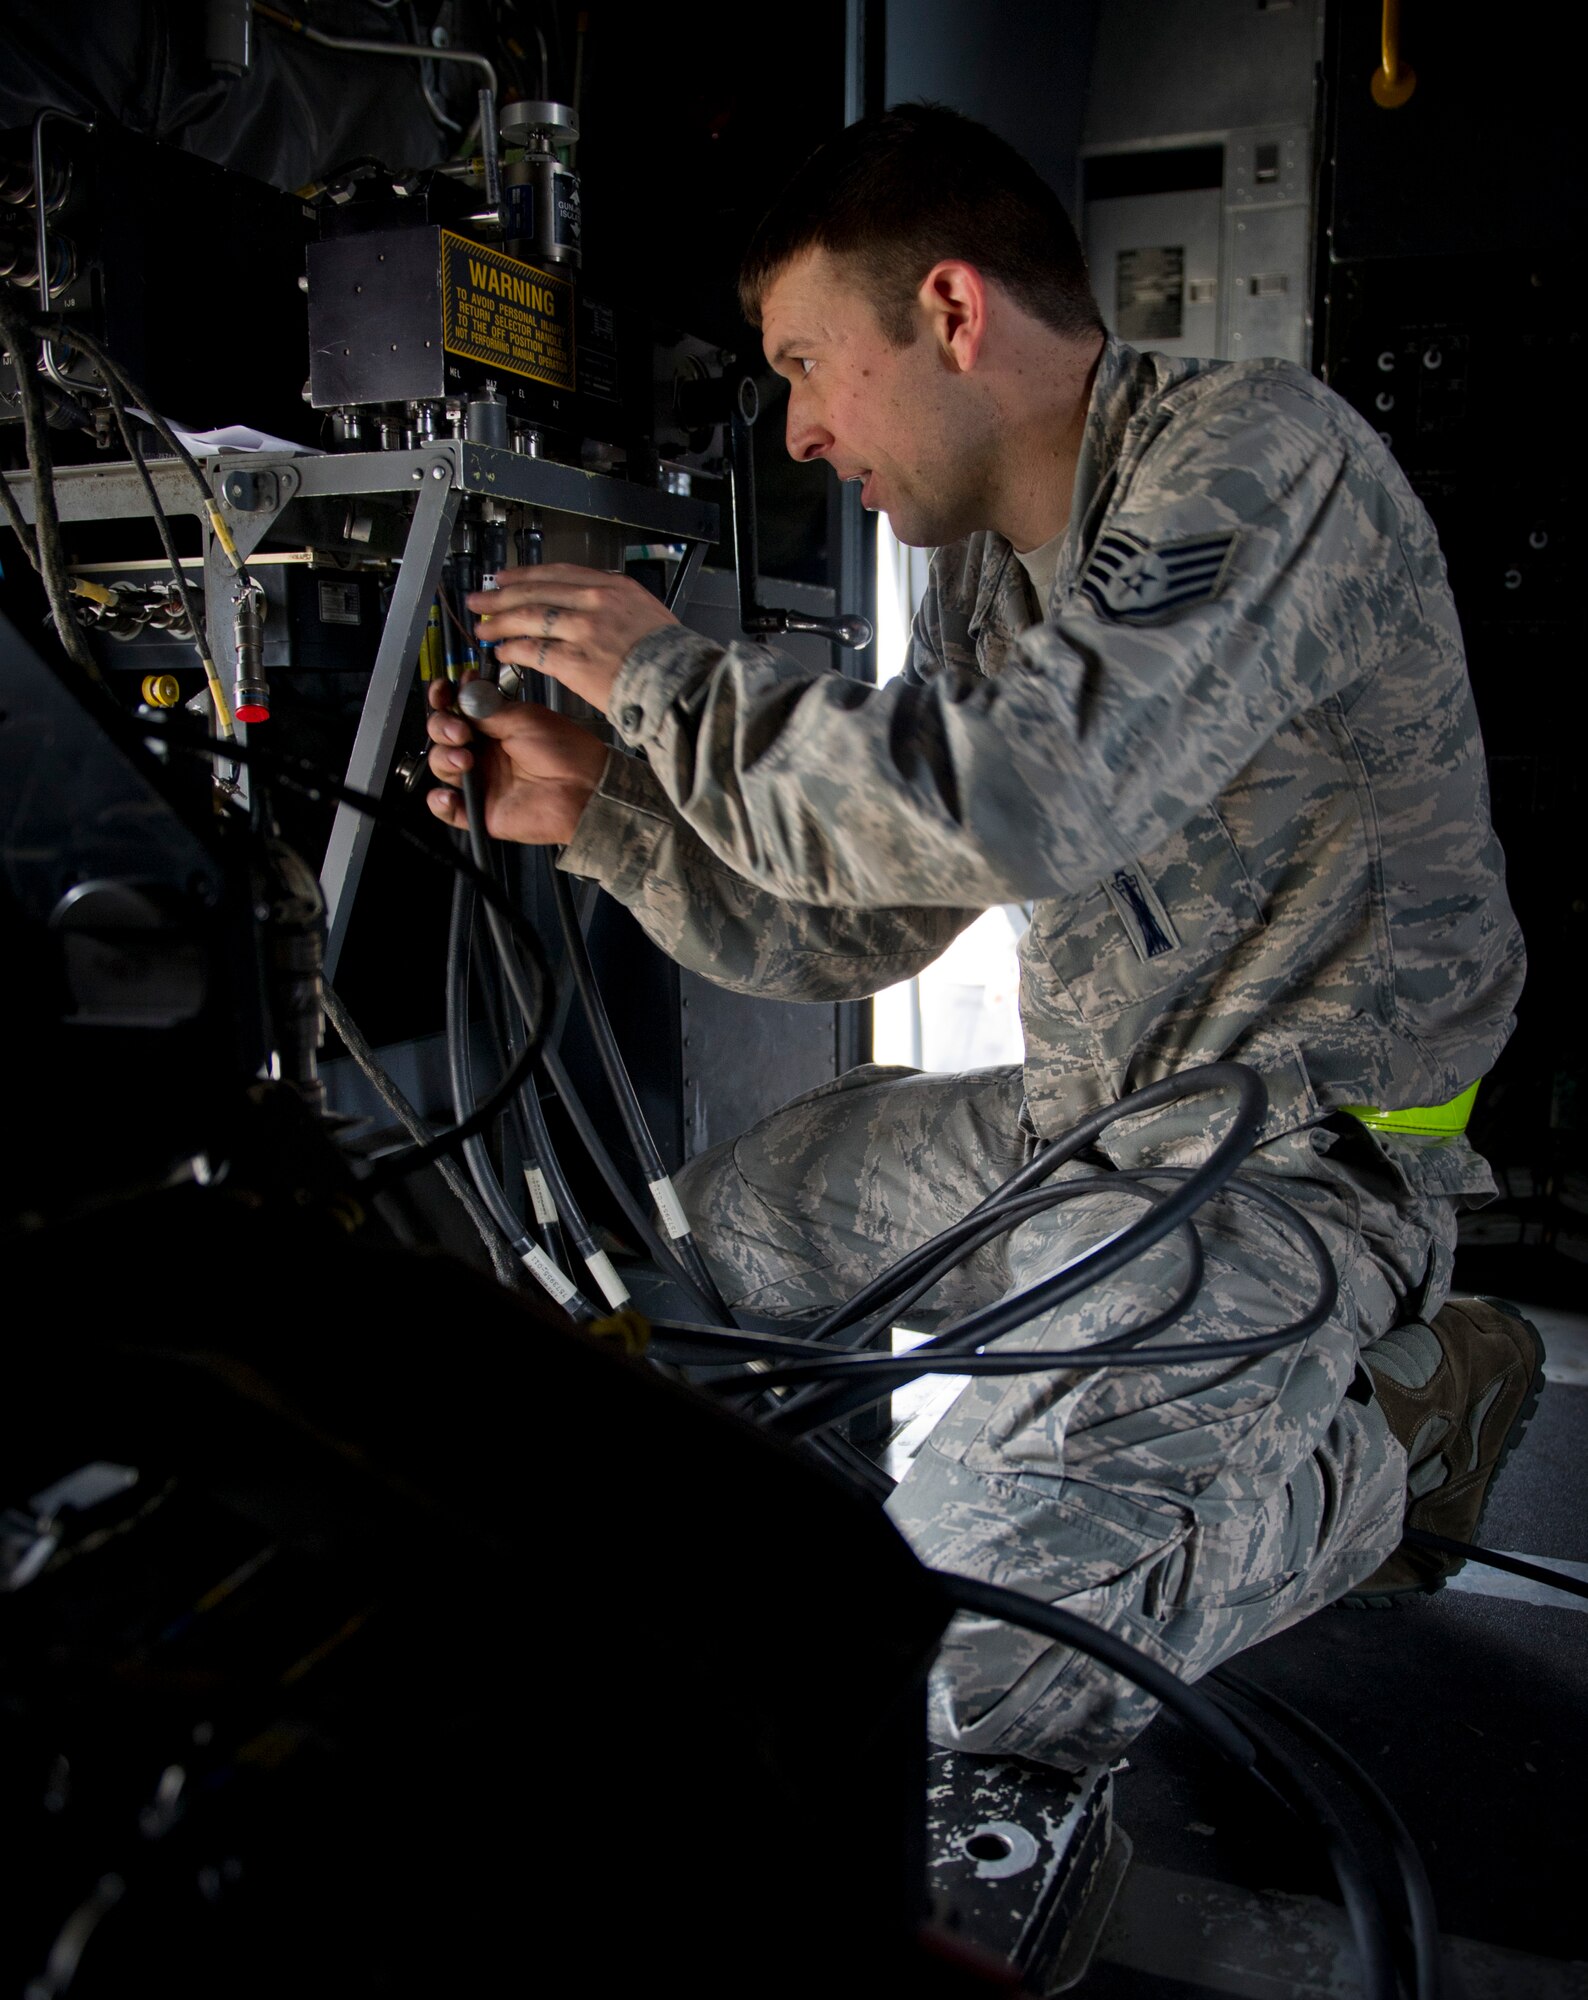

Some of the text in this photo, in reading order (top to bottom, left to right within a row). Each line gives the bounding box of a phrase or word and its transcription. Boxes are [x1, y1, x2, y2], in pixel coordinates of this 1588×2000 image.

[468, 258, 555, 317] WARNING
[456, 287, 567, 337] TO AVOID PERSONAL INJURY
[459, 301, 565, 347] RETURN SELECTOR HANDLE
[455, 325, 468, 341] NOT
[471, 333, 510, 355] PERFORMING
[512, 347, 537, 364] MANUAL
[457, 313, 567, 361] TO THE OFF POSITION WHEN
